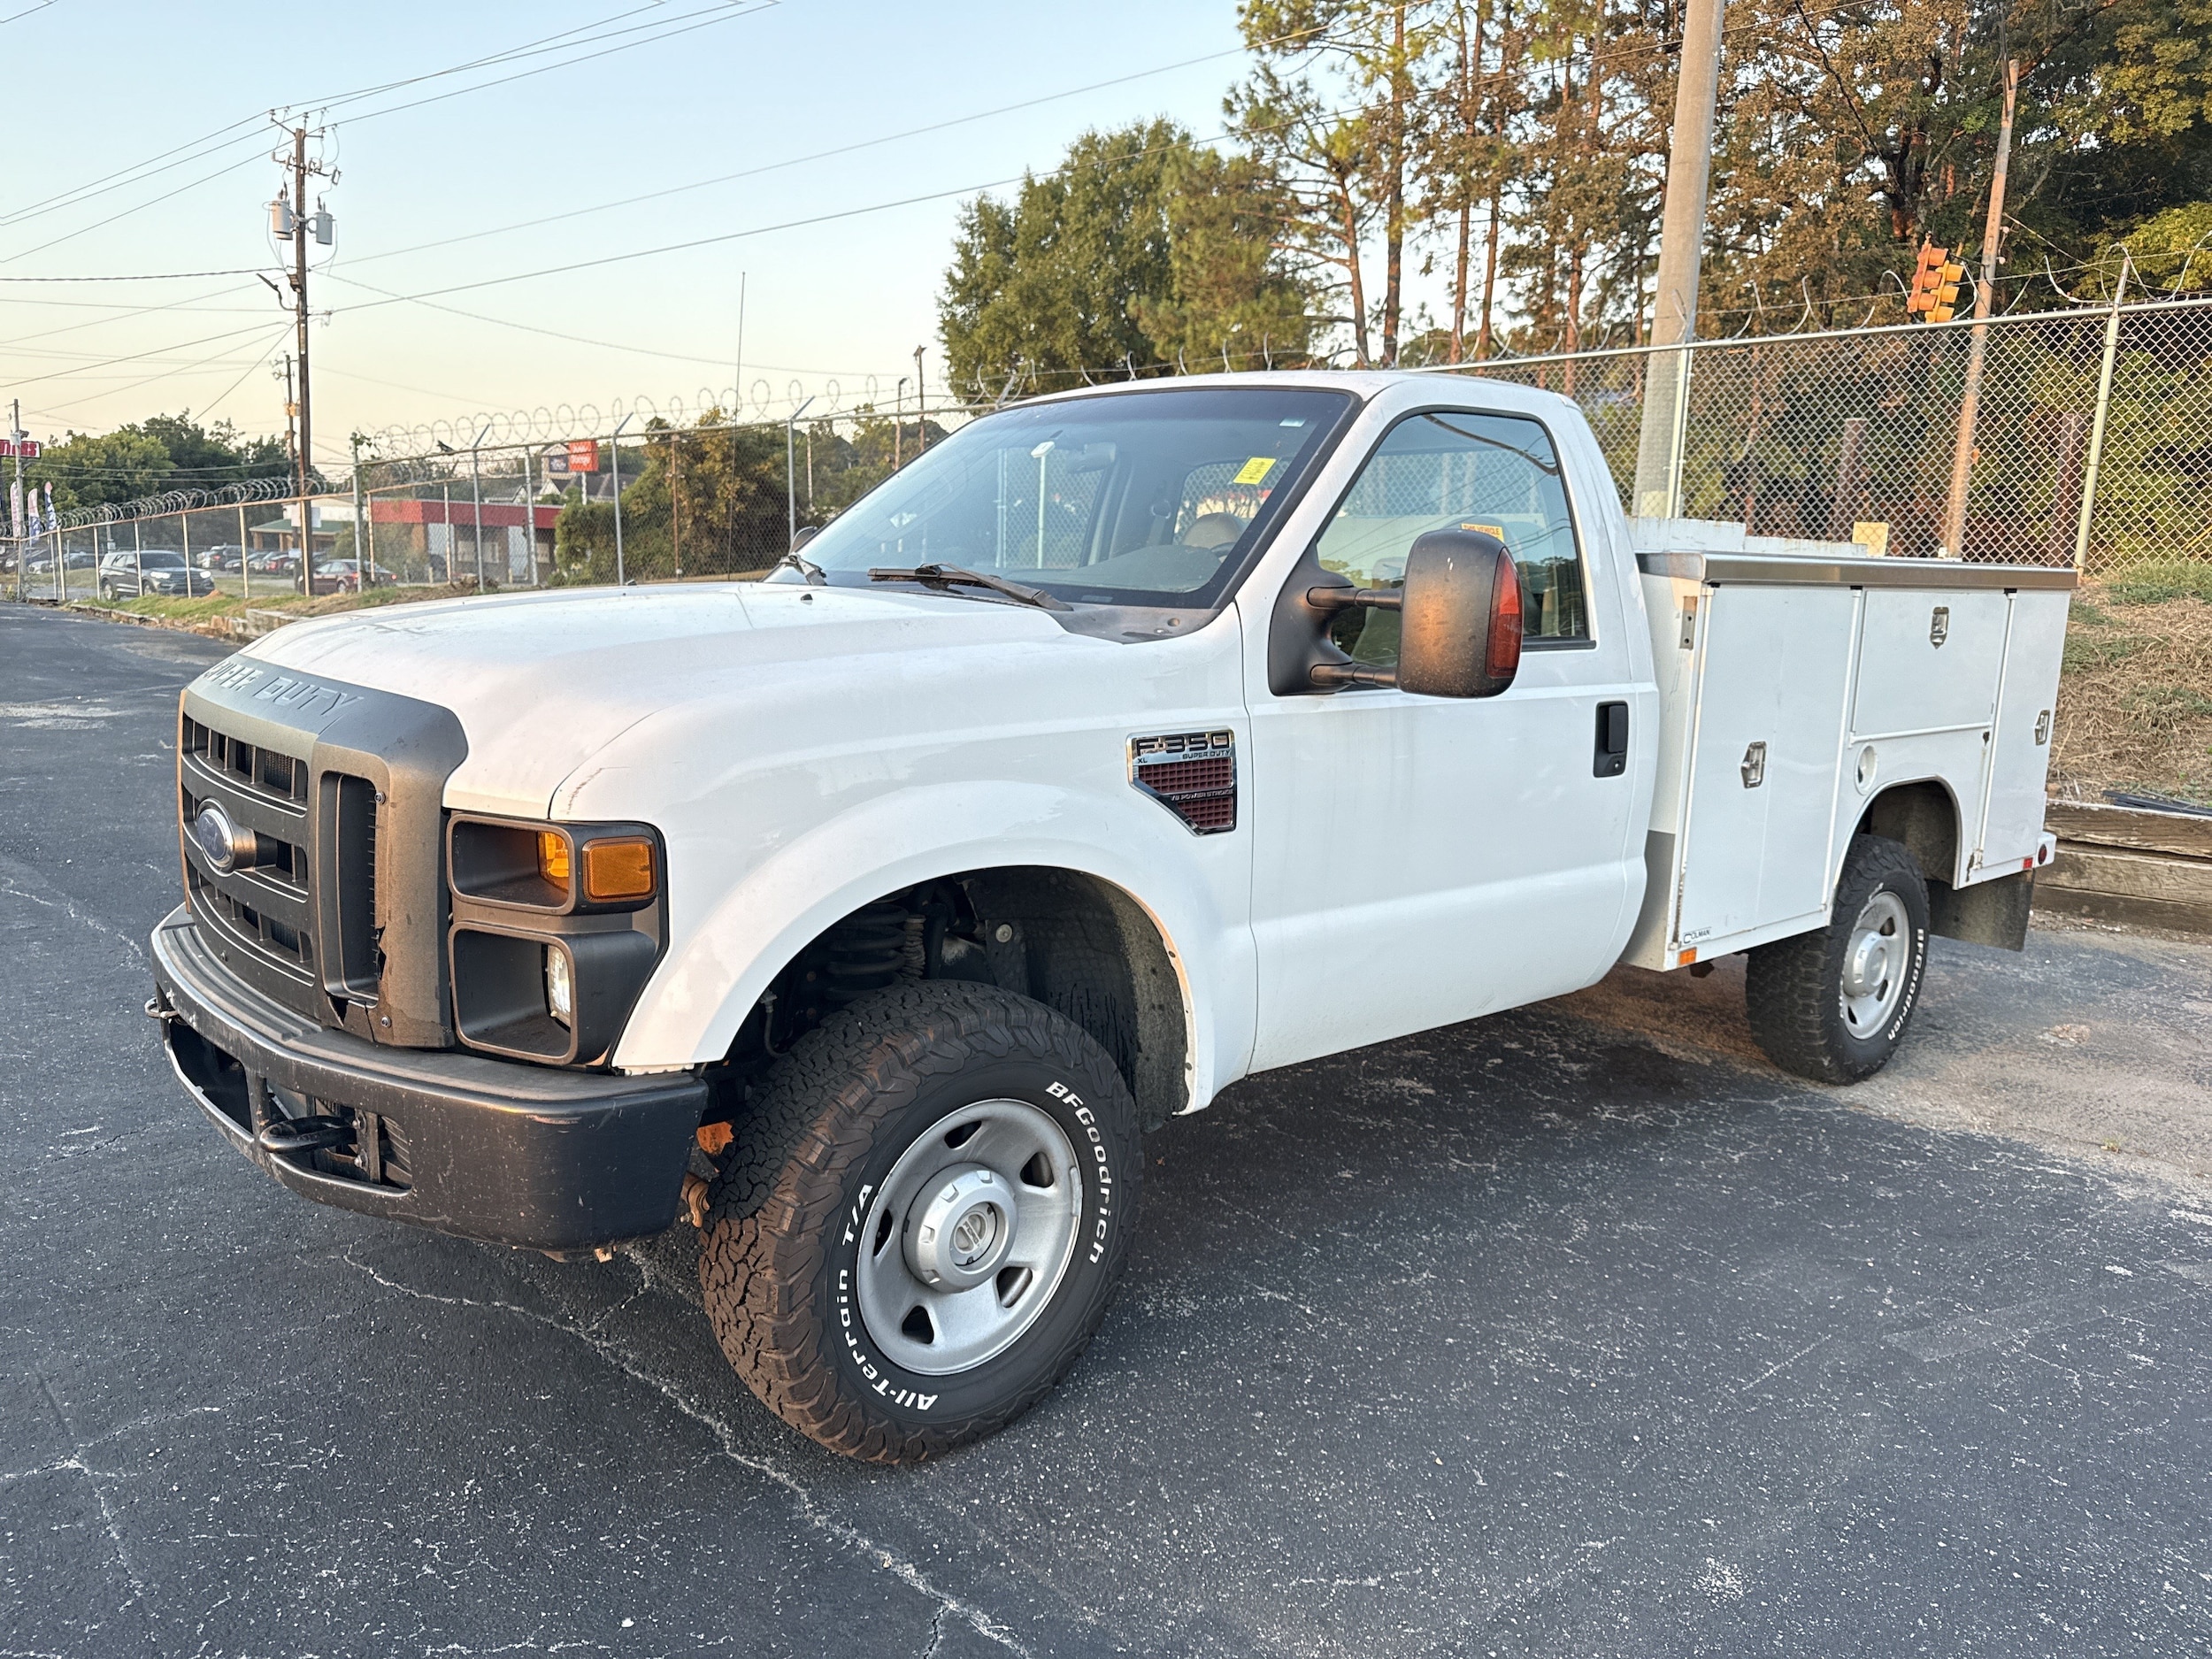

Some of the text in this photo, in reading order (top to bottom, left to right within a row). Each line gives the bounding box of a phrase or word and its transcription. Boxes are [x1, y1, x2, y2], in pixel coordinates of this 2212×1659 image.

[252, 677, 365, 716] DUTY
[1182, 751, 1209, 760] SUPER
[1180, 792, 1206, 801] POWER
[1206, 788, 1234, 798] STROKE
[1683, 929, 1710, 944] COLMAN
[1887, 928, 1924, 1041] BFGoodrich
[1045, 1080, 1112, 1264] BFGoodrich
[835, 1184, 939, 1411] All-Terrain T/A
